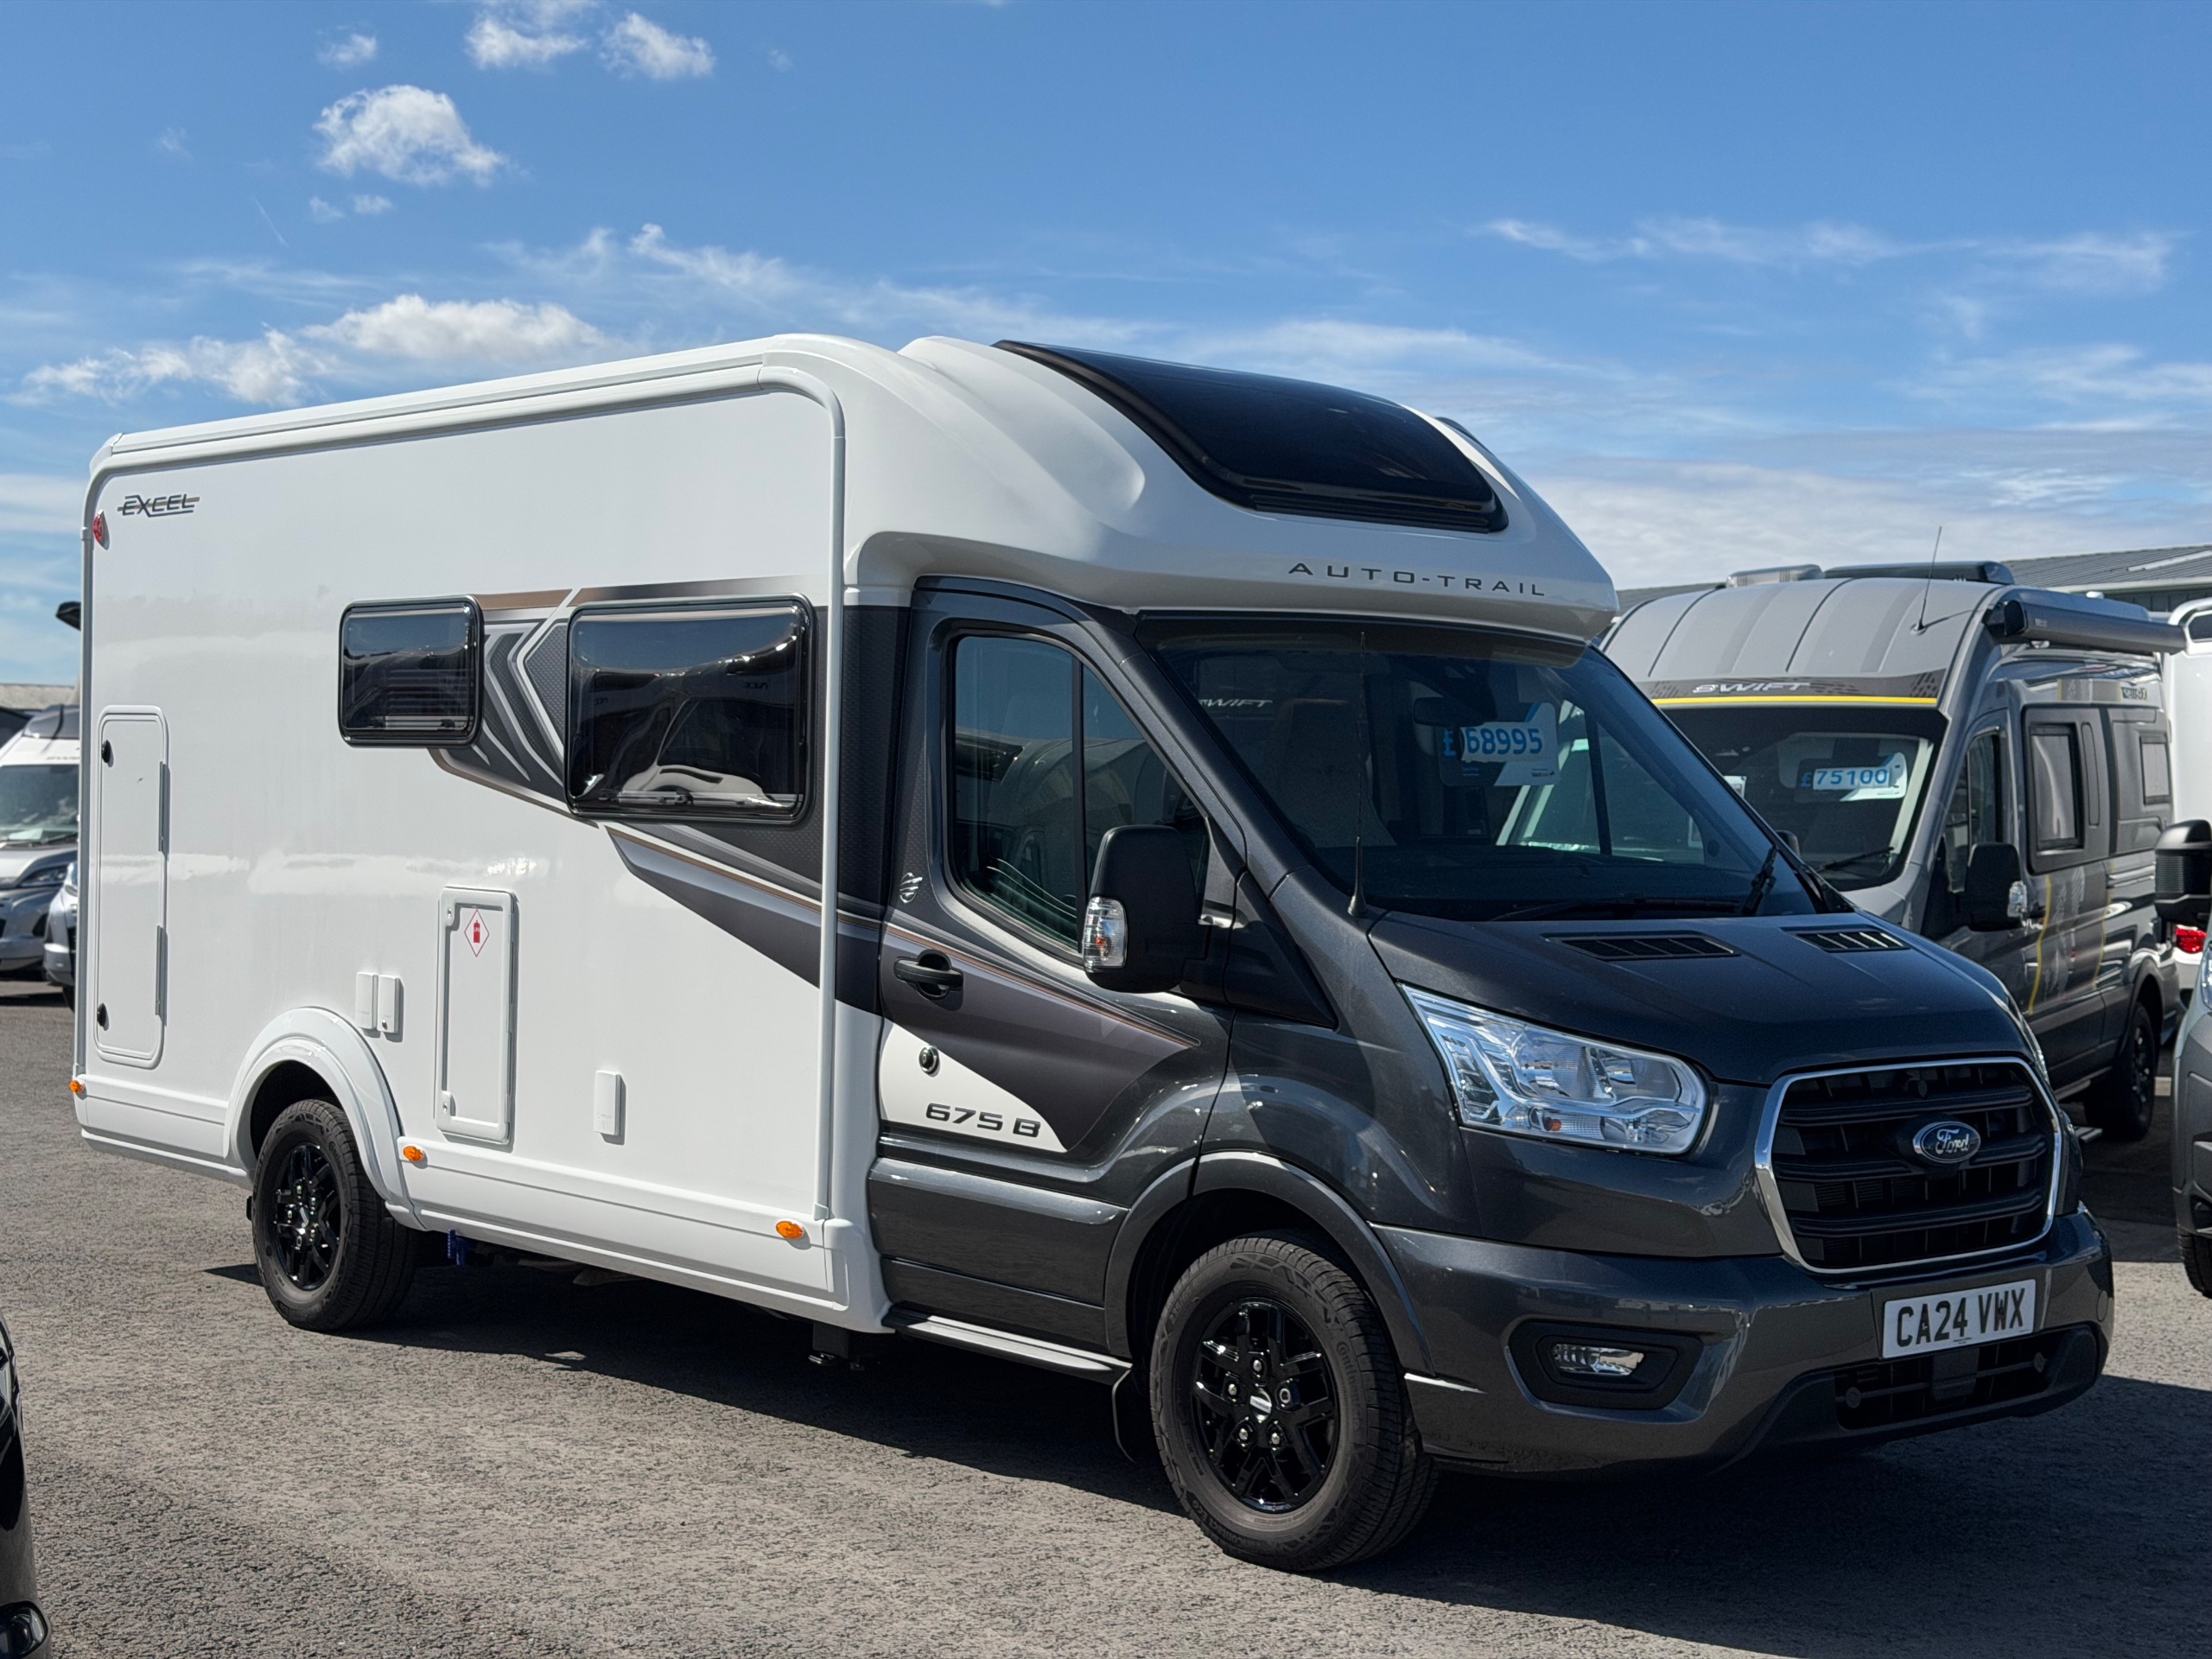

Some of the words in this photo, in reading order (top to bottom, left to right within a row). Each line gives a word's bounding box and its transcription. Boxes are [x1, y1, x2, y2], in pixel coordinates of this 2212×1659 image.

[122, 493, 196, 518] EXCEL
[1288, 563, 1545, 596] AUTO-TRAIL
[1692, 682, 1811, 694] SWIFT
[925, 1103, 1003, 1132] 675
[1012, 1117, 1041, 1138] B
[1936, 1128, 1970, 1155] Ford
[1897, 1297, 1969, 1348] CA24
[1978, 1287, 2026, 1334] VWX
